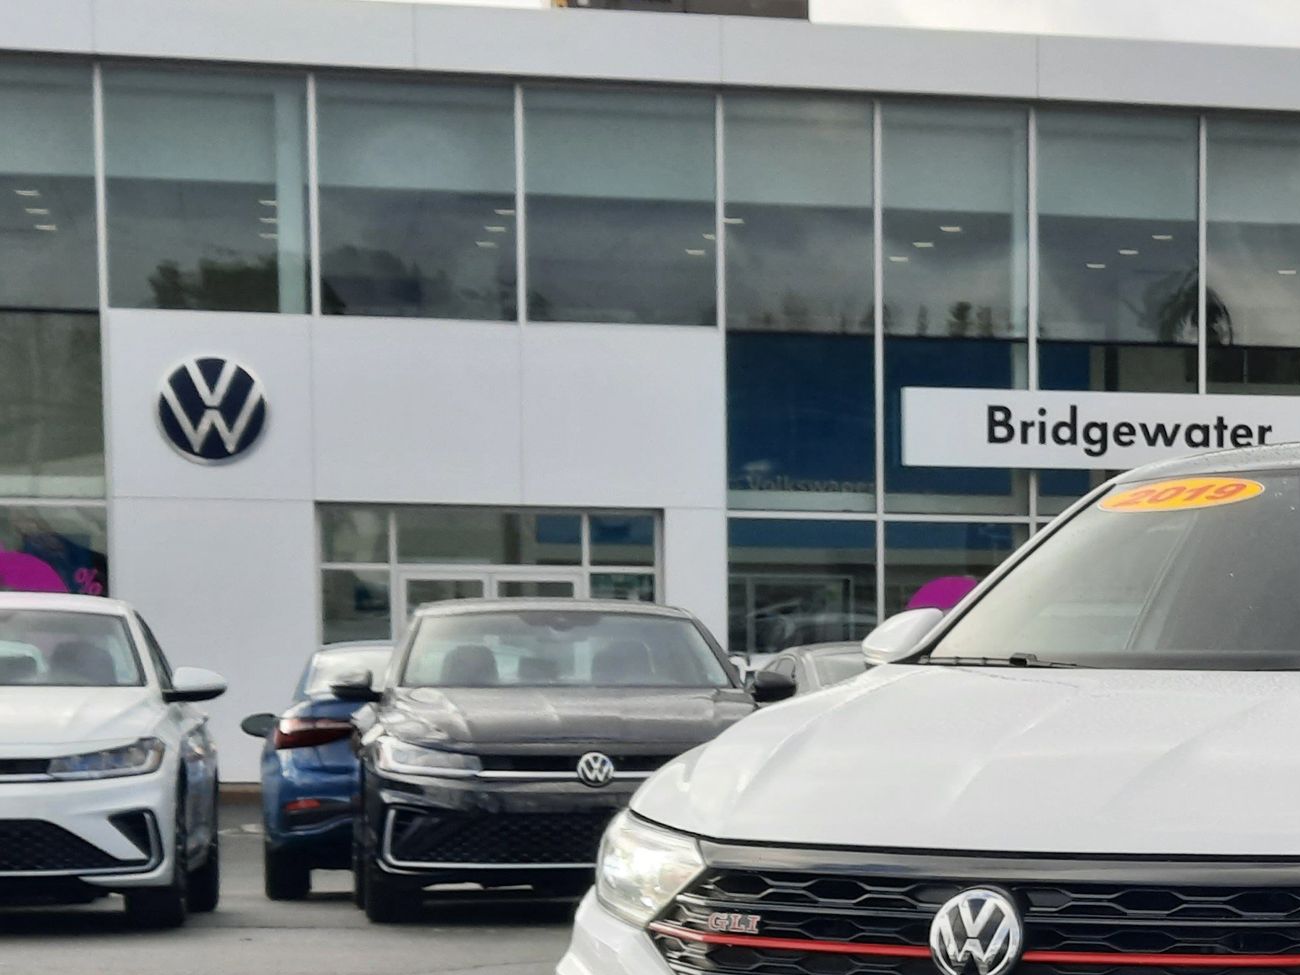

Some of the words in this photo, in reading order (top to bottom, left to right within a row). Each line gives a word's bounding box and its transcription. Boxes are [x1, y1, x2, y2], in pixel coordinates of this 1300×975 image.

[986, 404, 1273, 457] Bridgewater
[1111, 482, 1248, 508] 2019
[707, 911, 761, 935] GLI
